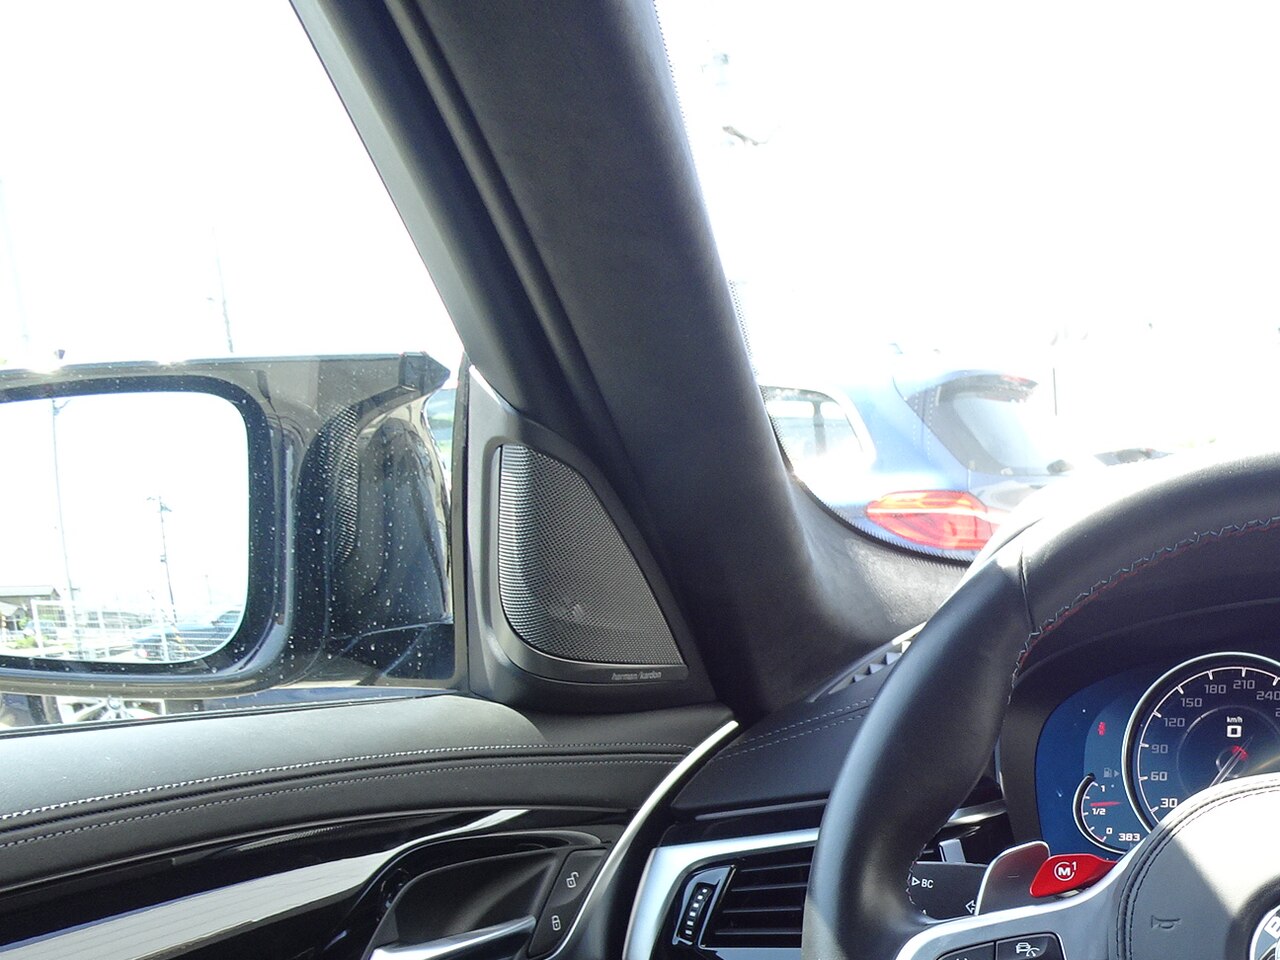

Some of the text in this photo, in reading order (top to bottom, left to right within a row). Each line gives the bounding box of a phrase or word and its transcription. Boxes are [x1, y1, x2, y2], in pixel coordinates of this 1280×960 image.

[1204, 684, 1227, 694] 180
[1233, 679, 1256, 690] 210
[1180, 697, 1203, 708] 150
[1163, 718, 1186, 728] 120
[1226, 716, 1243, 724] km/h
[1226, 725, 1242, 738] 0
[1151, 743, 1169, 754] 90
[1150, 771, 1168, 781] 60
[1160, 797, 1178, 808] 30
[1092, 807, 1106, 816] 1/2
[1105, 827, 1113, 835] 0
[1118, 832, 1141, 842] 383
[921, 878, 934, 889] BC
